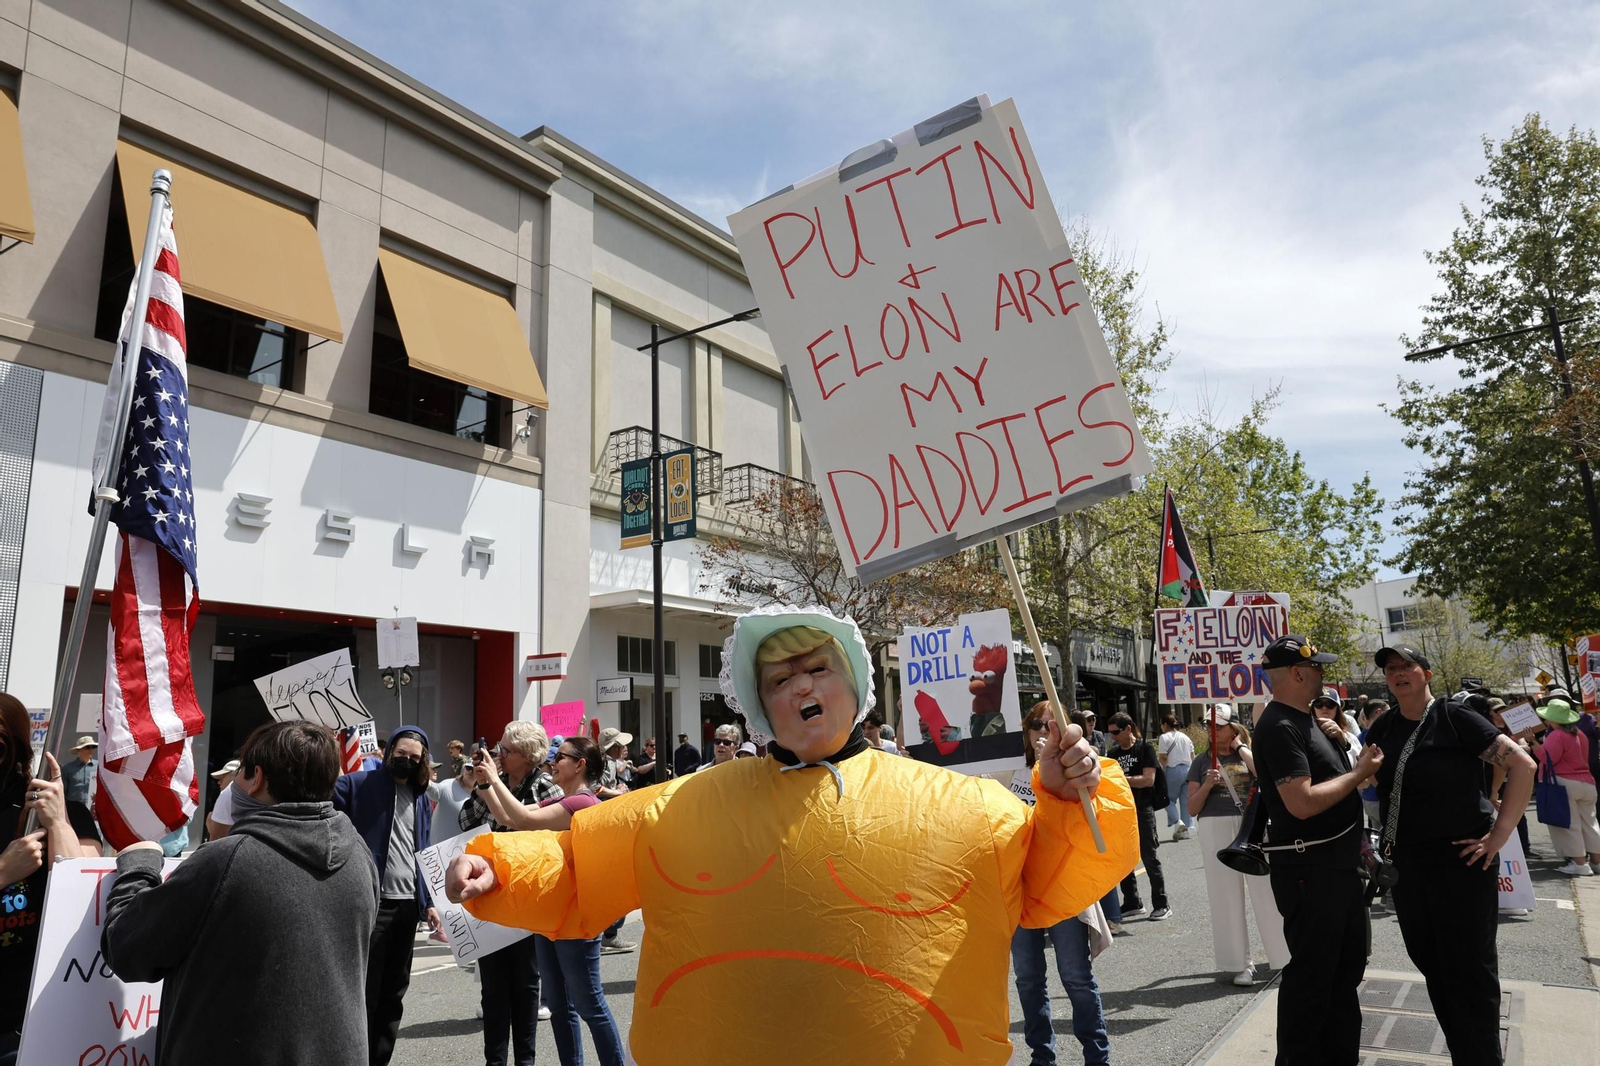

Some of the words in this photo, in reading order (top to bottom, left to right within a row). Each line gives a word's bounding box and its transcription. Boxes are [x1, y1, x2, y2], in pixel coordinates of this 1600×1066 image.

[764, 127, 1034, 299] PUTIN
[807, 292, 961, 400] ELON
[995, 258, 1079, 331] ARE
[900, 358, 988, 427] MY
[624, 467, 648, 488] WALNUT
[672, 459, 684, 479] EAT
[827, 383, 1134, 564] DADDIES
[624, 510, 648, 529] TOGETHER
[670, 500, 689, 518] LOCAL
[911, 629, 951, 657] NOT
[962, 626, 975, 648] A
[528, 662, 560, 671] TESLA
[907, 654, 967, 686] DRILL
[1188, 651, 1212, 665] AND
[1216, 651, 1242, 665] THE
[265, 656, 350, 711] deport
[700, 693, 715, 701] 1254
[1163, 663, 1273, 700] FELON
[420, 849, 445, 896] TRUMP
[1504, 860, 1522, 875] TO
[444, 909, 476, 959] DUMP
